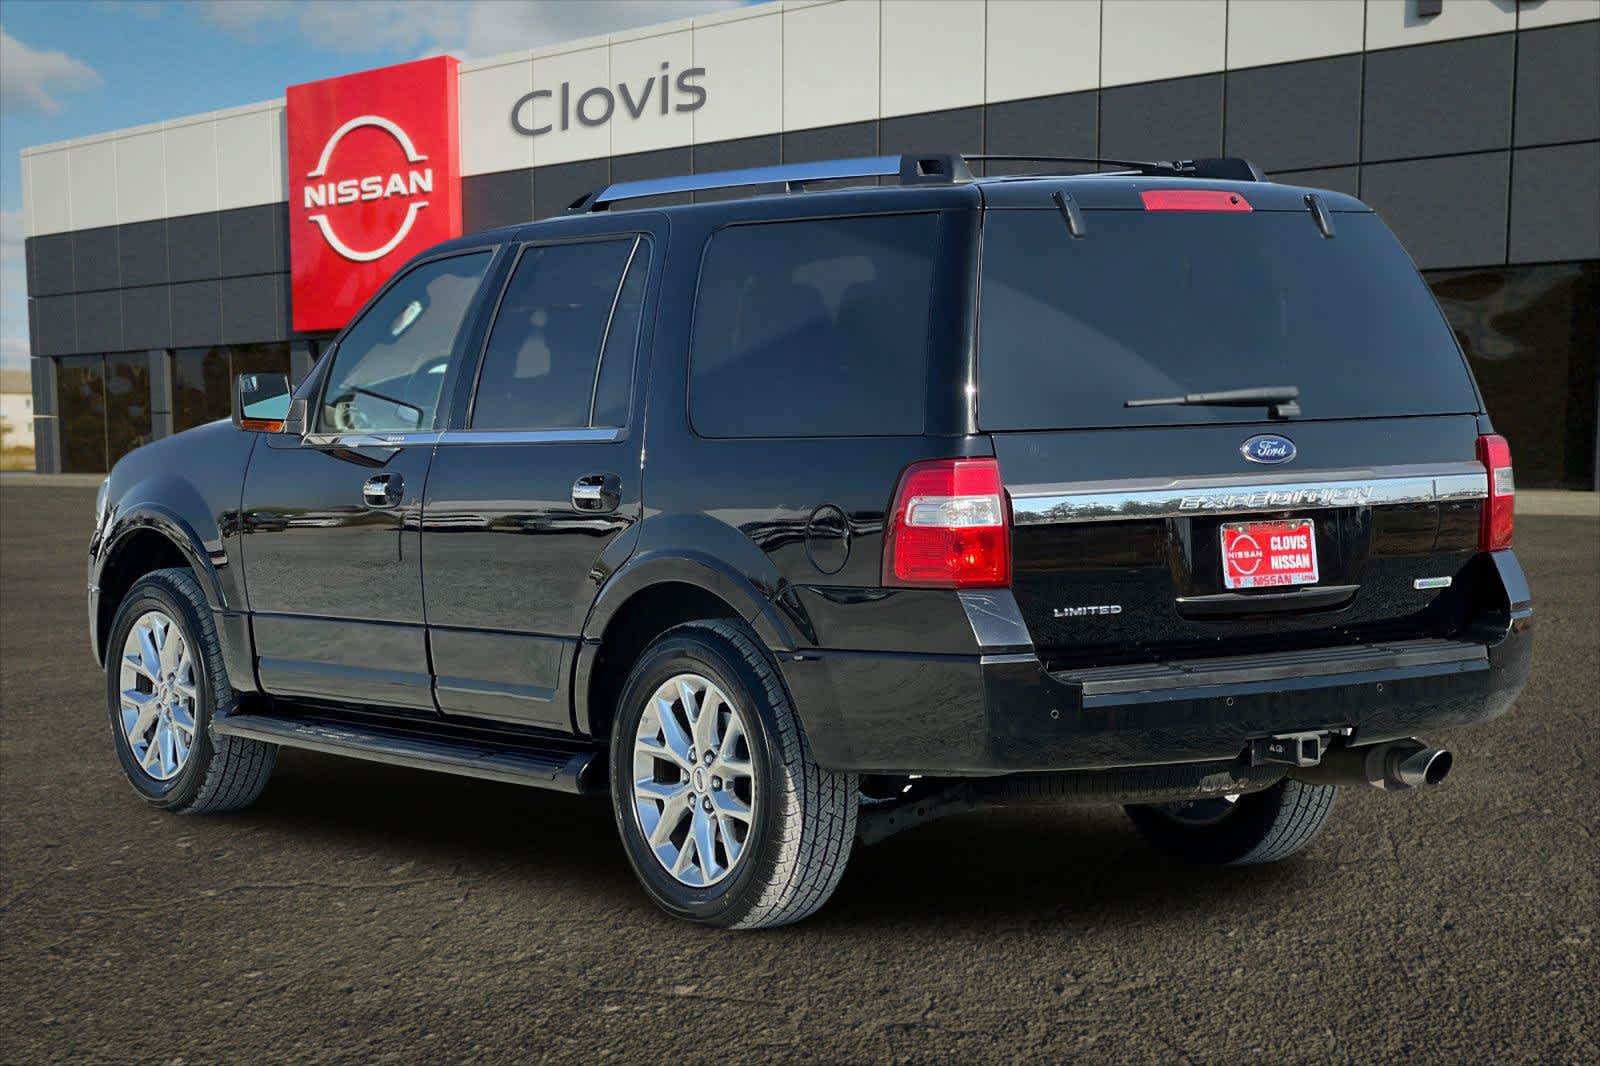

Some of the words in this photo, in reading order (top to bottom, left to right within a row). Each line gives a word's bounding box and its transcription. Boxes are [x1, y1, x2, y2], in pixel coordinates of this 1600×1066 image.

[511, 62, 707, 136] Clovis
[304, 169, 433, 208] NISSAN
[1258, 440, 1287, 457] Ford
[1178, 486, 1375, 510] EXPEDITION
[1270, 535, 1307, 551] CLOVIS
[1228, 550, 1263, 559] NISSAN
[1270, 554, 1310, 570] NISSAN
[1253, 574, 1293, 587] NISSAN
[1053, 605, 1122, 618] LIMITED
